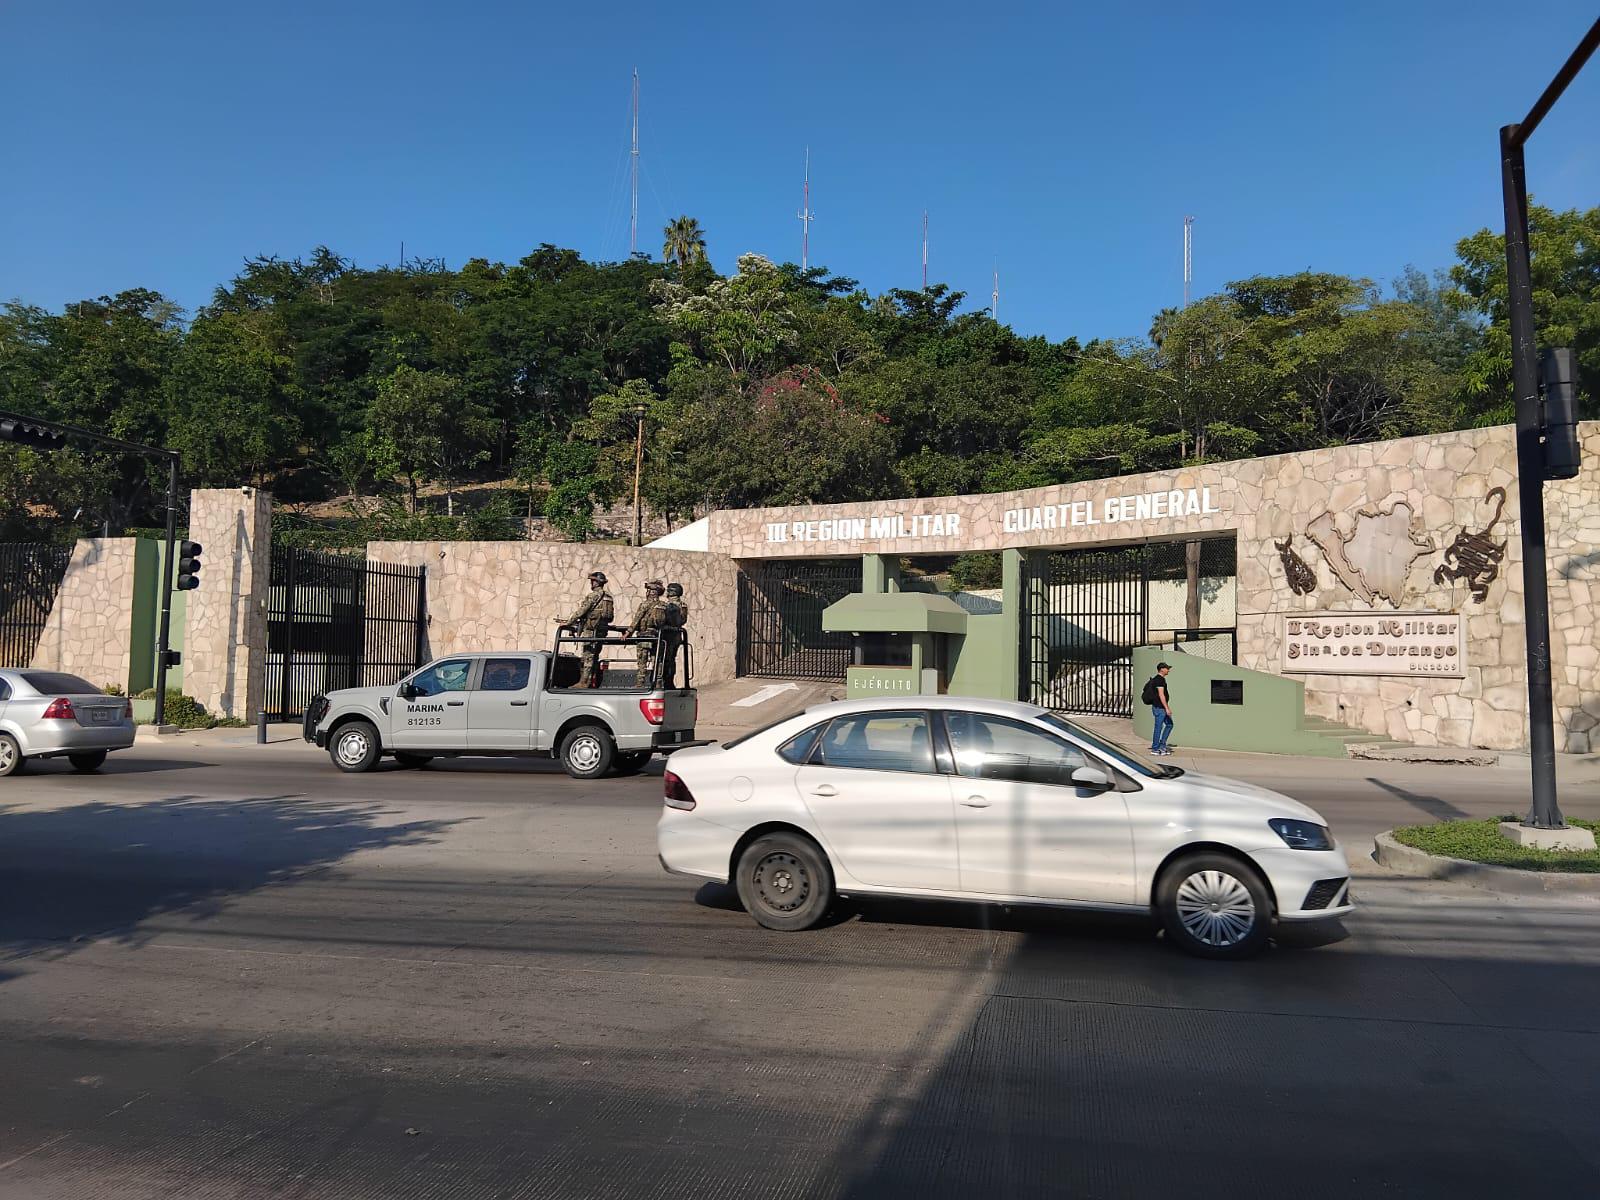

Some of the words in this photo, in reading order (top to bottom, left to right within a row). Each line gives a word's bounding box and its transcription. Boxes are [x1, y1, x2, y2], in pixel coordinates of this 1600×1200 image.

[1004, 501, 1100, 533] CUARTEL
[1104, 487, 1220, 524] GENERAL
[767, 522, 788, 543] III
[792, 518, 866, 542] REGION
[870, 513, 961, 539] MILITAR
[1304, 621, 1375, 639] Region
[1378, 620, 1457, 638] Militar
[1366, 641, 1458, 660] Durango
[407, 704, 444, 713] MARINA
[407, 717, 441, 726] 812135
